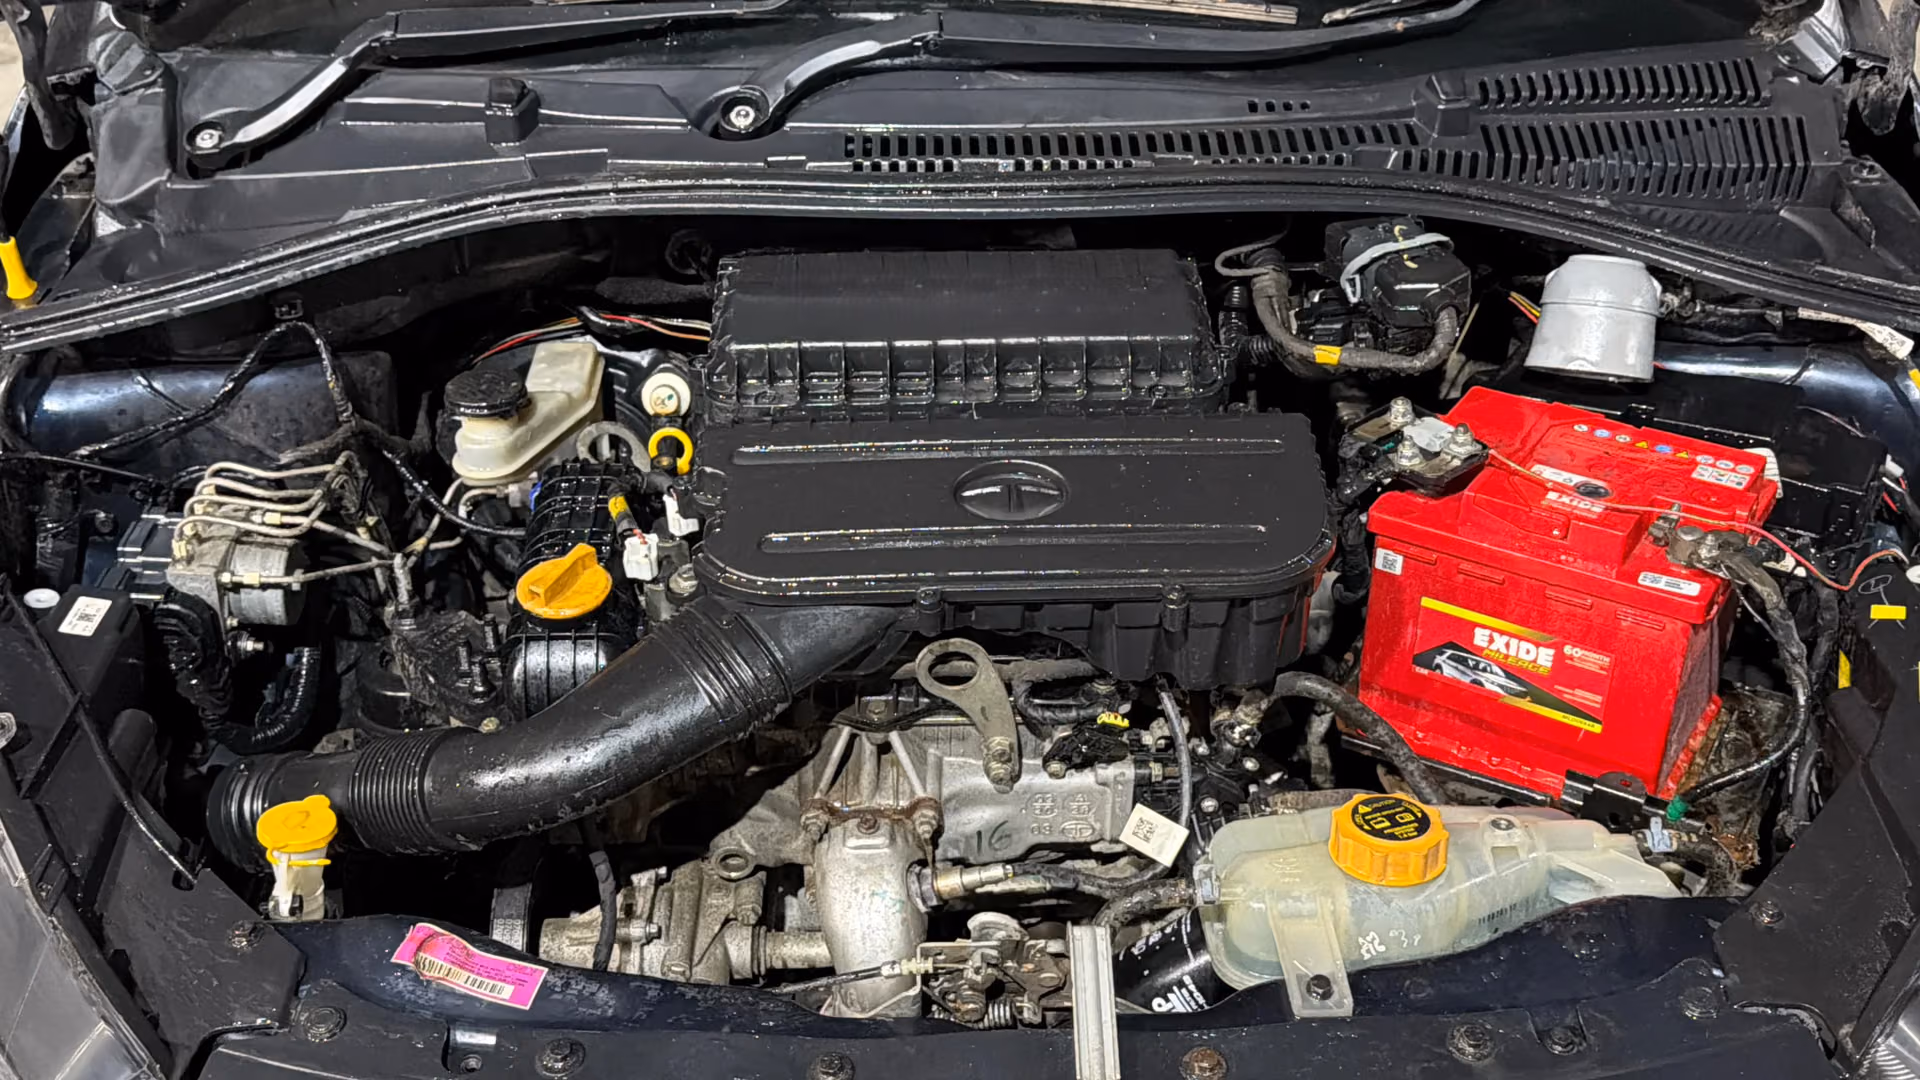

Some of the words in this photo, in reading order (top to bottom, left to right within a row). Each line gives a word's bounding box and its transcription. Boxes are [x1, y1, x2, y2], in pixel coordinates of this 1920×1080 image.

[1473, 627, 1556, 668] EXIDE
[1563, 644, 1582, 658] 60
[1482, 649, 1552, 676] MILEAGE
